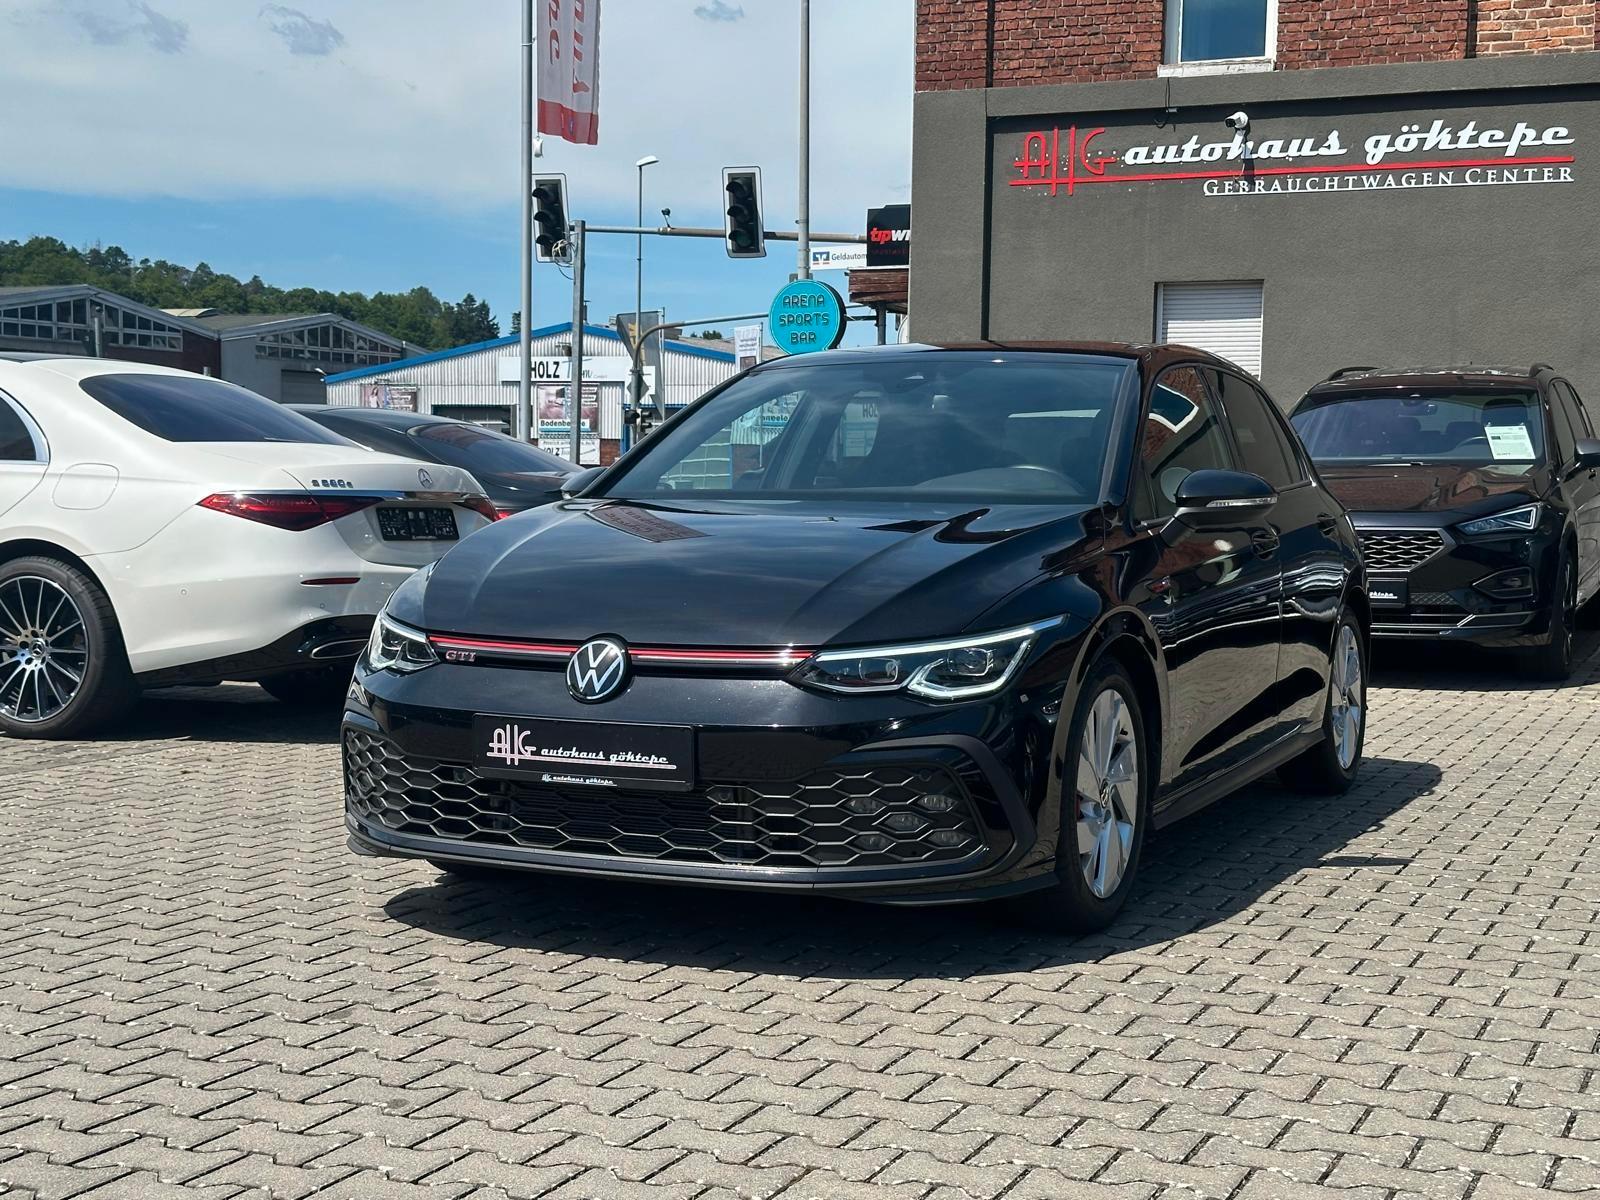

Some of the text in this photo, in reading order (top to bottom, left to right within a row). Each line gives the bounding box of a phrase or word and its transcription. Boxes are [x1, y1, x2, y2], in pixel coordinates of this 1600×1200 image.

[1124, 130, 1347, 166] autohaus
[1364, 119, 1576, 165] göktepe
[1465, 166, 1575, 185] CENTER
[782, 294, 825, 309] ARENA
[778, 312, 830, 328] SPORTS
[790, 331, 817, 345] BAR
[444, 650, 477, 662] GTI
[488, 723, 669, 766] AHG autohaus göktepe
